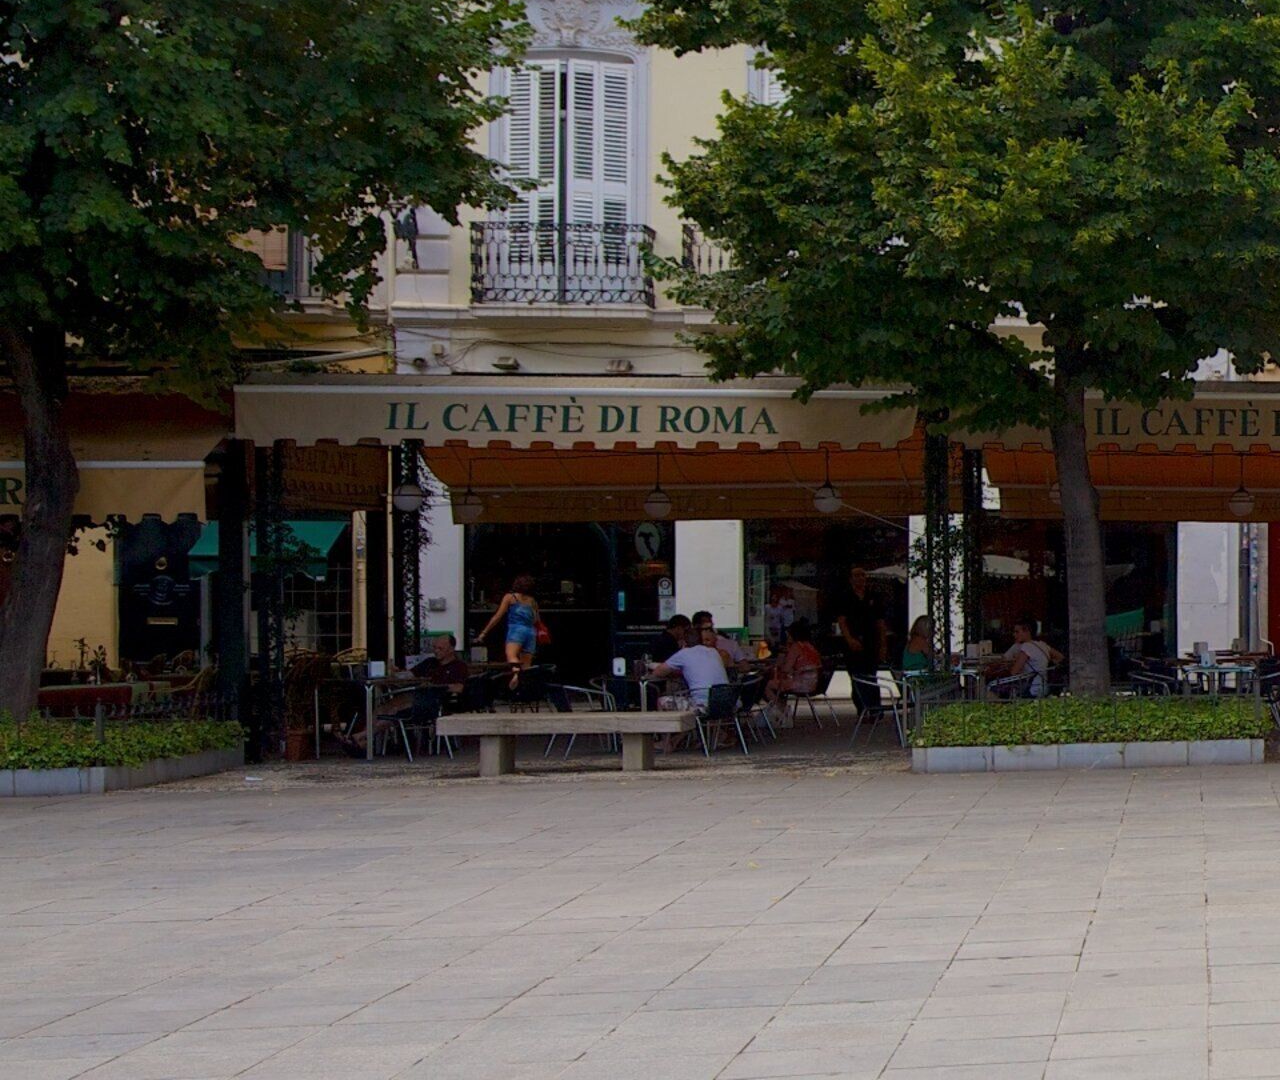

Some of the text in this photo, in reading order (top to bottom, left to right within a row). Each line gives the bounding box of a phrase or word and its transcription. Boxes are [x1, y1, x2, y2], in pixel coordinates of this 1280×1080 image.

[385, 396, 779, 434] IL CAFFÈ DI ROMA
[1093, 407, 1131, 436] IL
[1141, 401, 1260, 437] CAFFÈ
